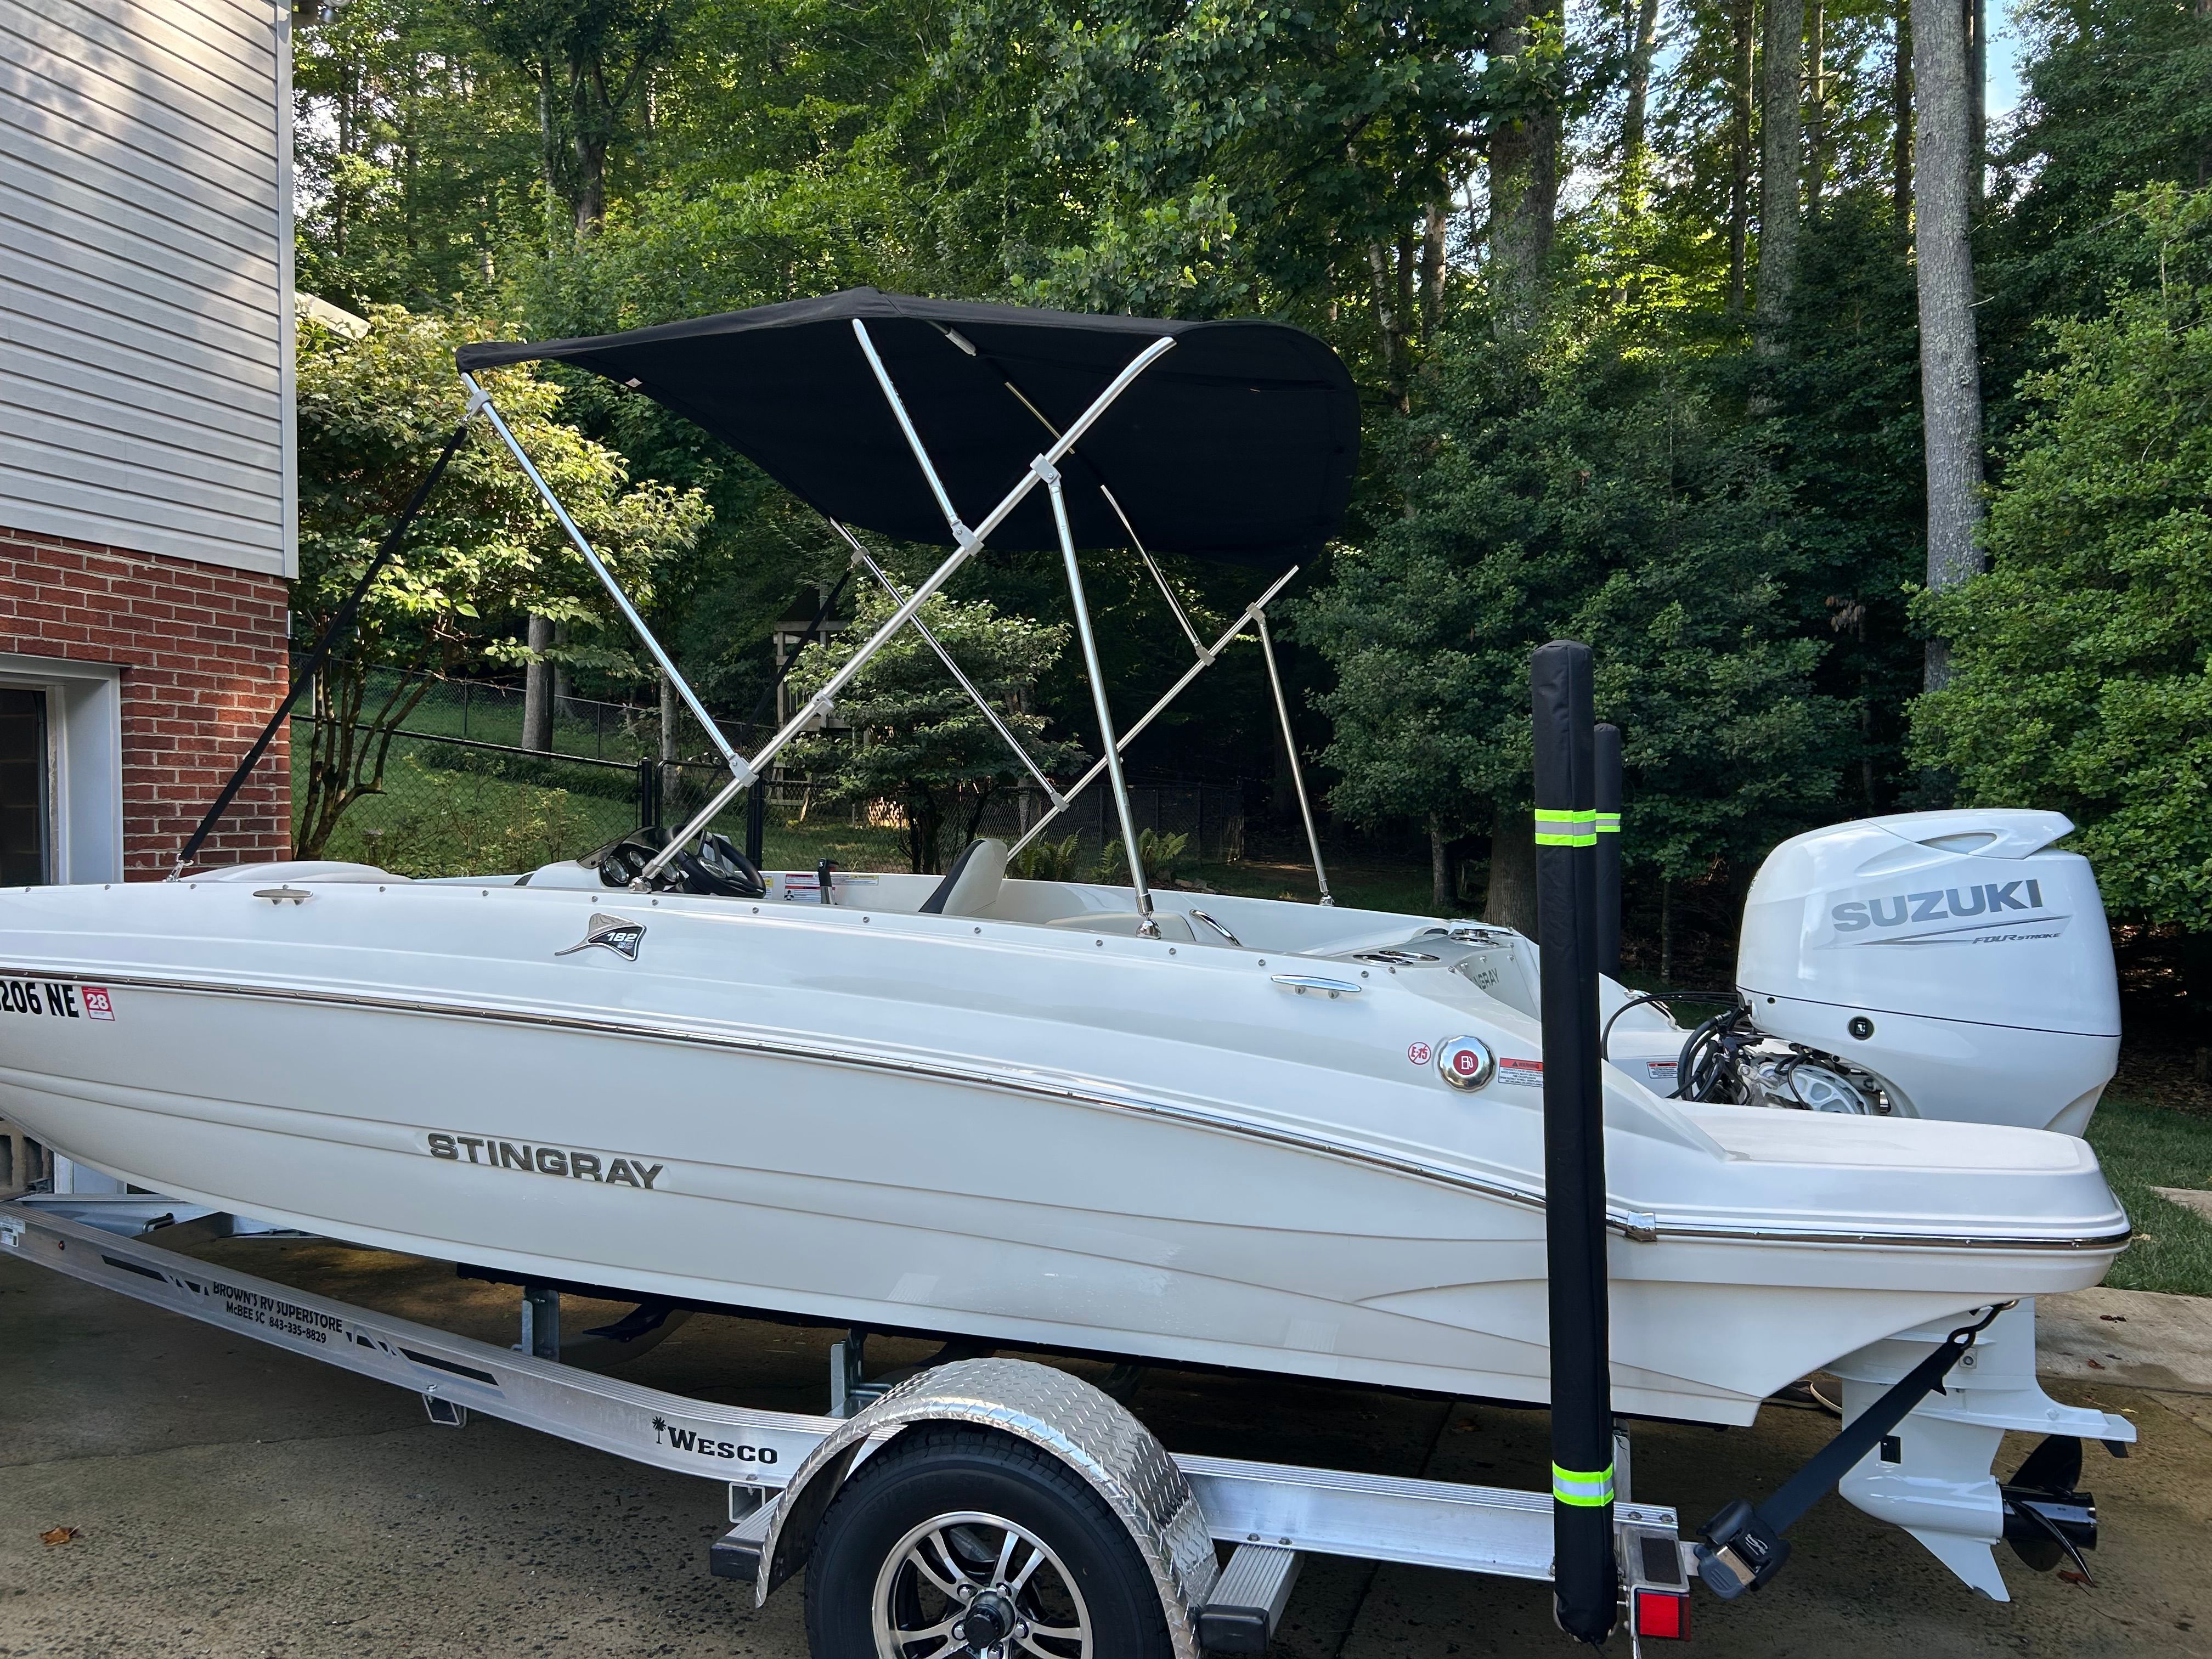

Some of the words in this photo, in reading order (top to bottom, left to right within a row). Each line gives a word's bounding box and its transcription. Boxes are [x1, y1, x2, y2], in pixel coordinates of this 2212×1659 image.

[1831, 879, 2044, 932] SUZUKI
[607, 932, 637, 942] 182
[0, 980, 42, 1015] 206
[44, 984, 80, 1018] NE
[87, 994, 109, 1010] 28
[428, 1132, 663, 1189] STINGRAY
[213, 1281, 257, 1307] BROWN'S
[260, 1296, 274, 1311] RV
[276, 1301, 343, 1333] SUPERSTORE
[226, 1301, 253, 1320] McBEE
[255, 1311, 265, 1324] SC
[269, 1317, 326, 1343] 843-335-8829
[667, 1426, 778, 1464] WESCO
